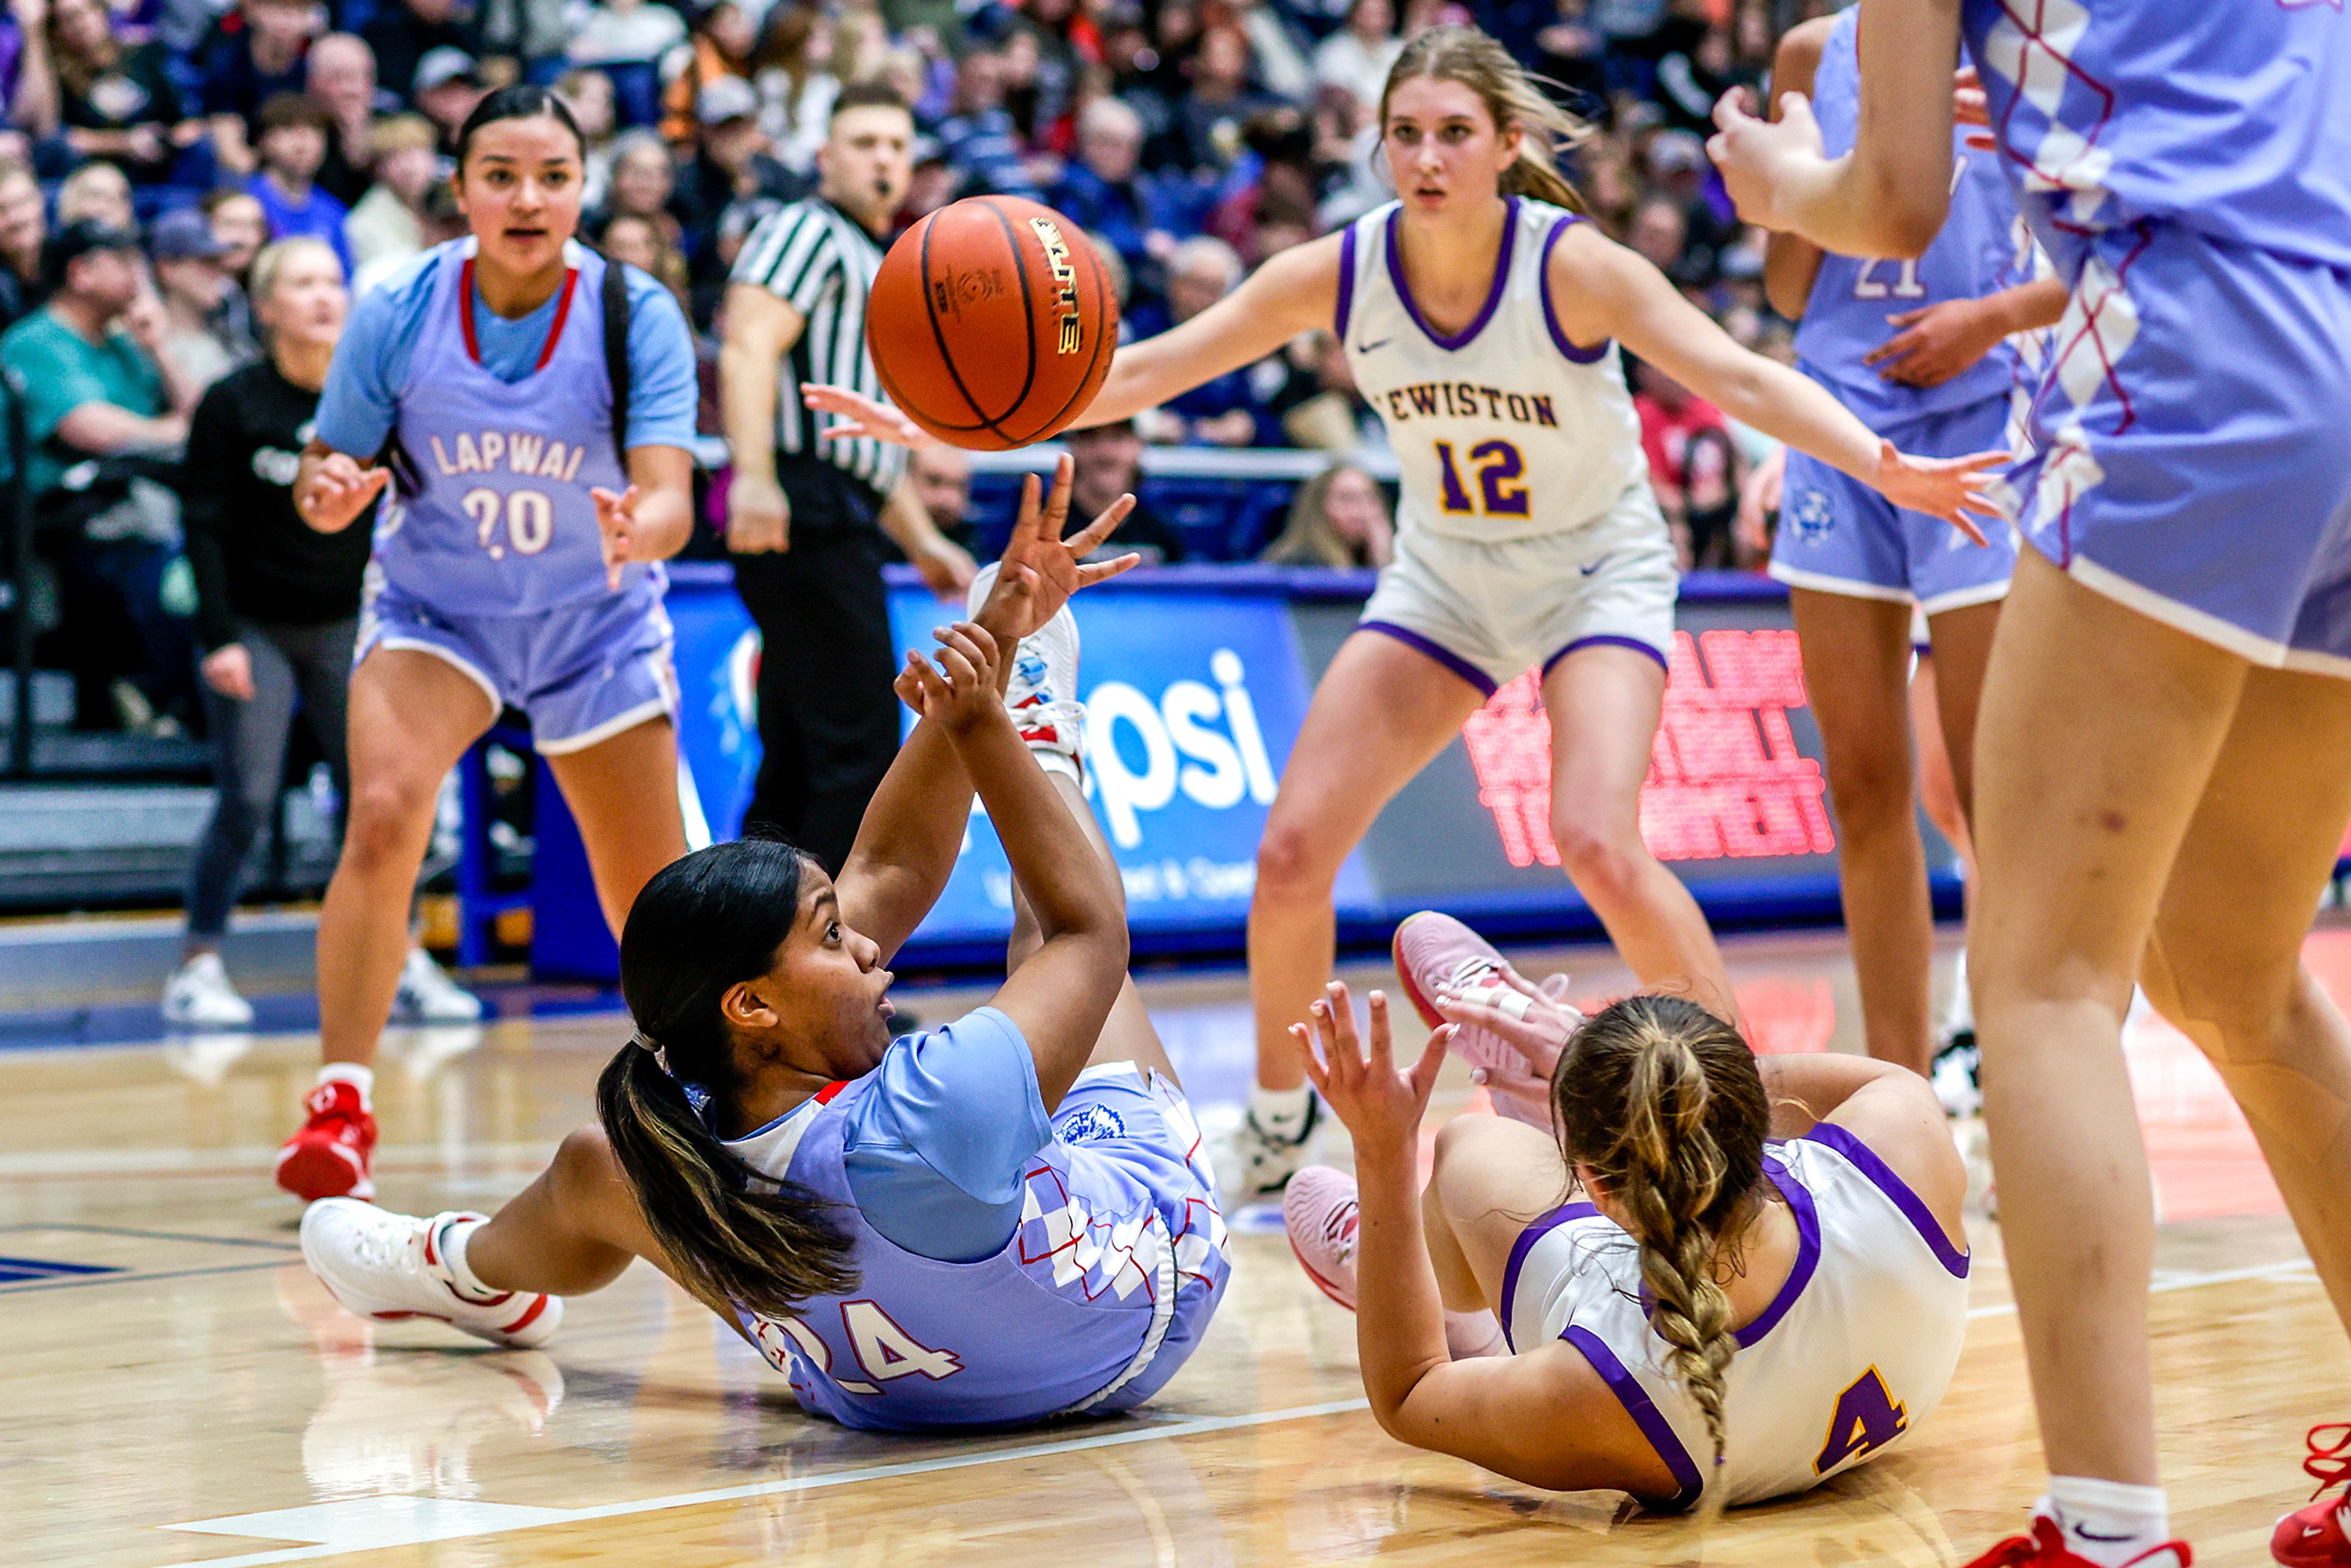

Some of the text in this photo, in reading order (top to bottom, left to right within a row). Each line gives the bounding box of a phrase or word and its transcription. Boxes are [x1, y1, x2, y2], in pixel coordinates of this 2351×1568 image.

[1373, 382, 1559, 429] EWISTON
[430, 430, 586, 482] LAPWAI
[1433, 438, 1533, 519] 12
[1812, 1362, 1910, 1477] 4
